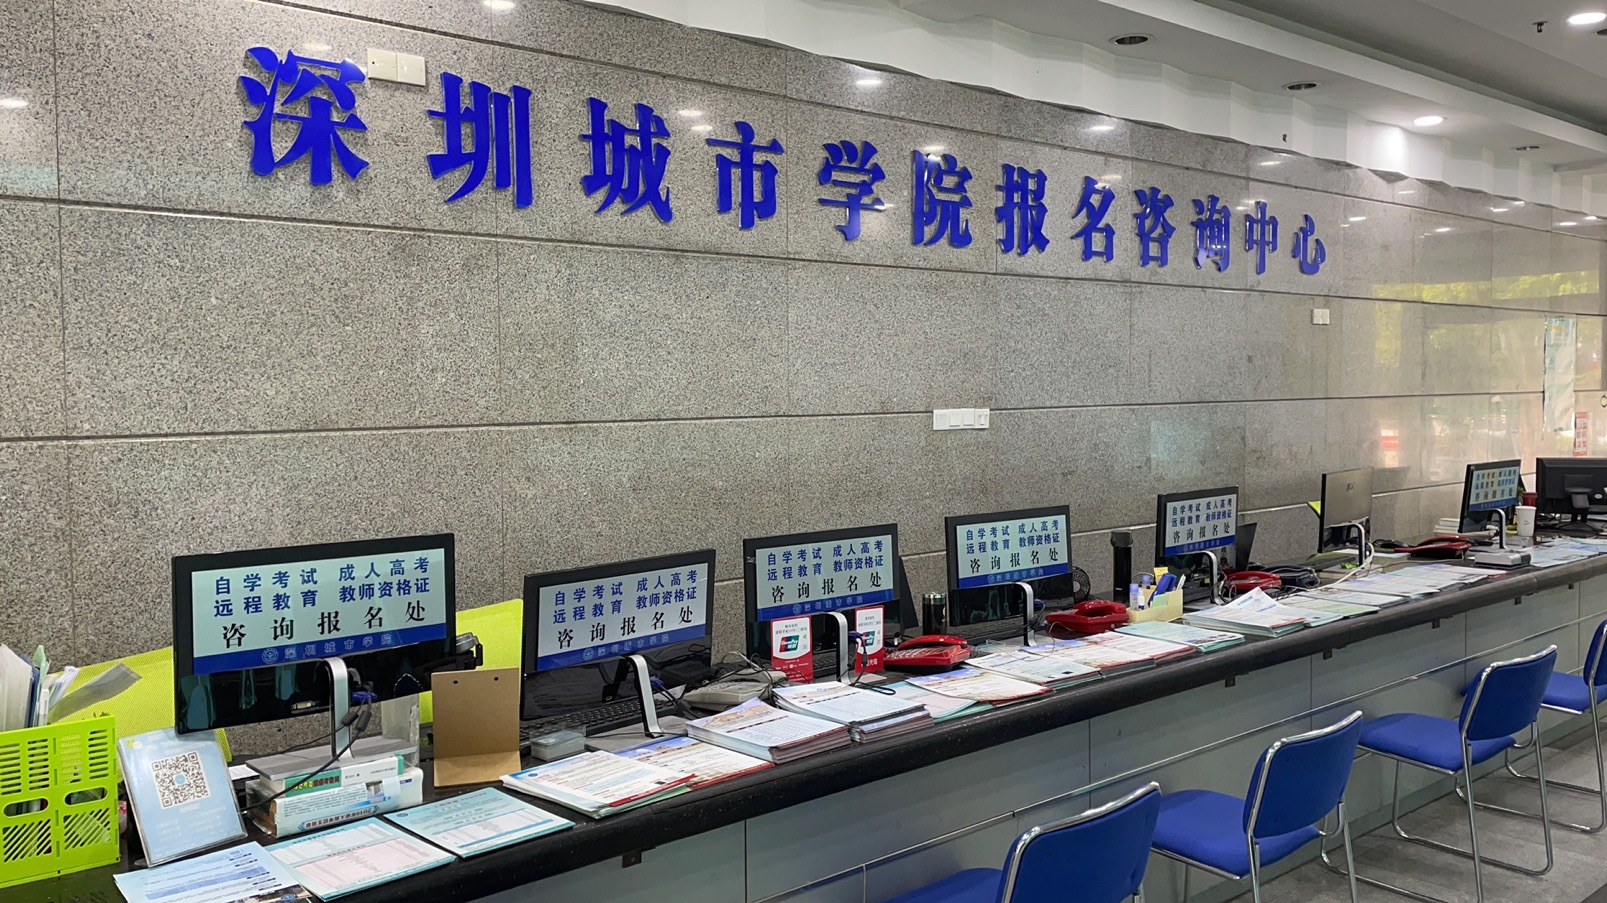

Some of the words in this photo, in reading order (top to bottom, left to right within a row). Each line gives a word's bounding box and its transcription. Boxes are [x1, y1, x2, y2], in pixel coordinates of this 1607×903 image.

[239, 46, 1327, 275] 深圳城市学院报名咨询中心
[966, 525, 1010, 541] 自学考试
[1018, 519, 1060, 534] 成人高考
[966, 539, 1010, 555] 远程教育
[1018, 533, 1060, 548] 教师资格证
[767, 547, 822, 566] 自学考试
[832, 540, 884, 558] 成人高考
[767, 562, 822, 581] 远程教育
[833, 554, 884, 573] 教师资格证
[970, 547, 1059, 574] 咨询报名处
[215, 568, 318, 596] 自学考试
[339, 556, 430, 582] 成人高考
[555, 581, 623, 606] 自学考试
[636, 569, 698, 592] 成人高考
[772, 571, 882, 604] 咨询报名处
[214, 589, 319, 618] 远程教育
[338, 577, 430, 603] 教师资格证
[553, 599, 623, 624] 远程教育
[636, 586, 697, 610] 教师资格证
[221, 599, 427, 649] 咨询报名处
[558, 605, 694, 650] 咨询报名处
